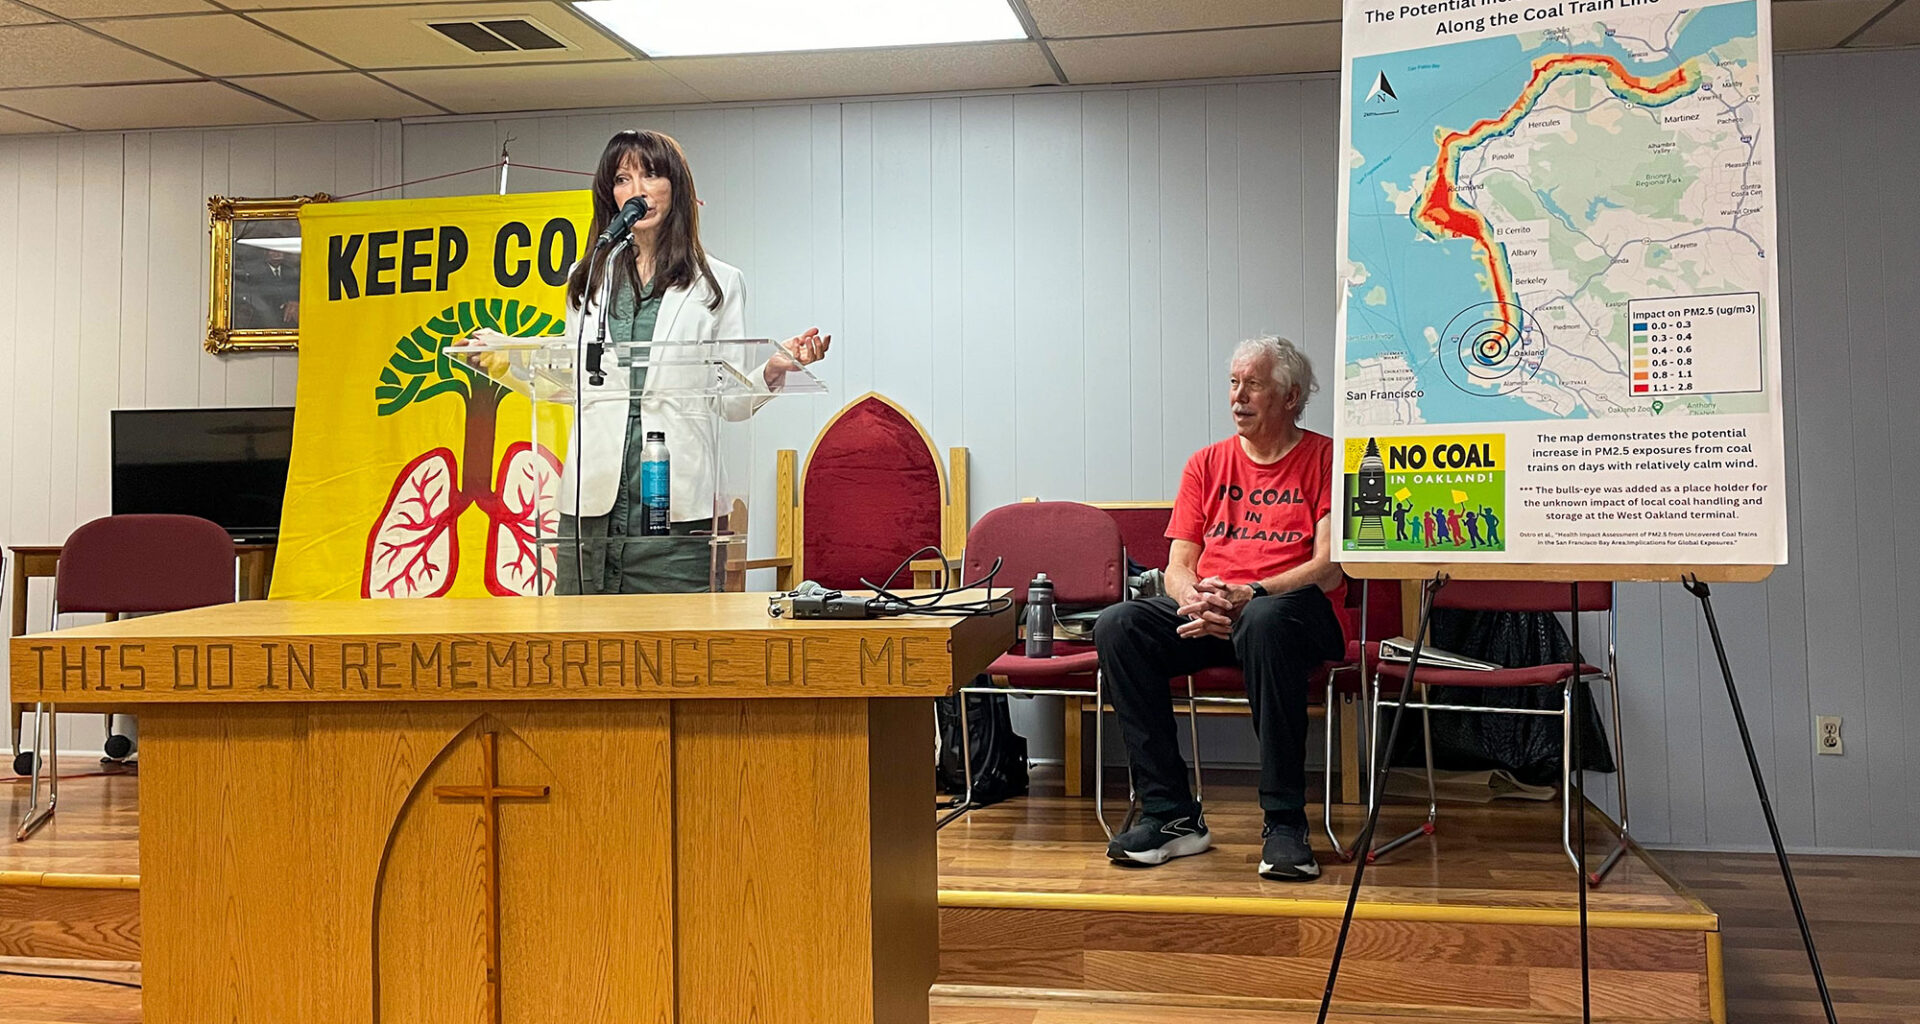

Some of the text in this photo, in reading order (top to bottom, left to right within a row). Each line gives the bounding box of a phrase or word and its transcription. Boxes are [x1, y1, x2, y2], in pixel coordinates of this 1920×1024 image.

[1365, 0, 1475, 23] The Potential
[1436, 16, 1486, 35] Along
[1490, 11, 1519, 26] the
[1524, 3, 1564, 20] Coal
[1569, 0, 1616, 14] Train
[1665, 113, 1700, 123] Martinez
[1529, 119, 1561, 129] Hercules
[1492, 152, 1515, 161] Pinole
[1448, 183, 1484, 193] Richmond
[1635, 179, 1666, 188] Regional
[1497, 227, 1531, 236] El Cerrito
[1511, 249, 1538, 258] Albany
[328, 217, 578, 302] KEEP CO
[1515, 277, 1548, 287] Berkeley
[1633, 310, 1666, 320] Impact
[1667, 310, 1681, 318] on
[1683, 306, 1714, 316] PM2.5
[1716, 303, 1756, 317] (ug/m3)
[1553, 324, 1581, 332] Piedmont
[1651, 322, 1667, 330] 0.0
[1676, 321, 1692, 329] 0.3
[1651, 334, 1668, 342] 0.3
[1676, 333, 1694, 341] 0.4
[1514, 349, 1545, 358] Oakland
[1651, 347, 1668, 355] 0.4
[1677, 345, 1693, 353] 0.6
[1652, 359, 1668, 367] 0.6
[1677, 358, 1694, 366] 0.8
[1652, 371, 1668, 380] 0.8
[1678, 370, 1693, 378] 1.1
[1653, 384, 1668, 392] 1.1
[1678, 382, 1694, 391] 2.8
[1346, 390, 1425, 400] San Francisco
[1638, 405, 1651, 413] Zoo
[1687, 402, 1717, 411] Anthony
[1537, 428, 1747, 444] The map demonstrates the potential
[1532, 443, 1752, 458] increase in PM2.5 exposures from coal
[1390, 443, 1496, 470] NO COAL
[1528, 463, 1559, 472] trains
[1579, 462, 1605, 473] days
[1608, 461, 1632, 470] with
[1635, 460, 1691, 472] relatively
[1694, 459, 1722, 469] calm
[1725, 458, 1758, 469] wind.
[1391, 472, 1494, 485] IN OAKLAND!
[1536, 486, 1554, 494] The
[1556, 485, 1602, 496] bulls-eye
[1604, 485, 1623, 493] was
[1626, 483, 1658, 493] added
[1660, 484, 1671, 492] as
[1683, 484, 1711, 494] place
[1714, 483, 1749, 492] holder
[1752, 482, 1768, 491] for
[1249, 488, 1304, 505] COAL
[1524, 496, 1763, 508] the unknown impact of local coal handling and
[1245, 511, 1262, 524] IN
[1546, 510, 1740, 522] storage at the West Oakland terminal.
[31, 635, 931, 692] THIS DO IN REMEMBRANCE OF ME
